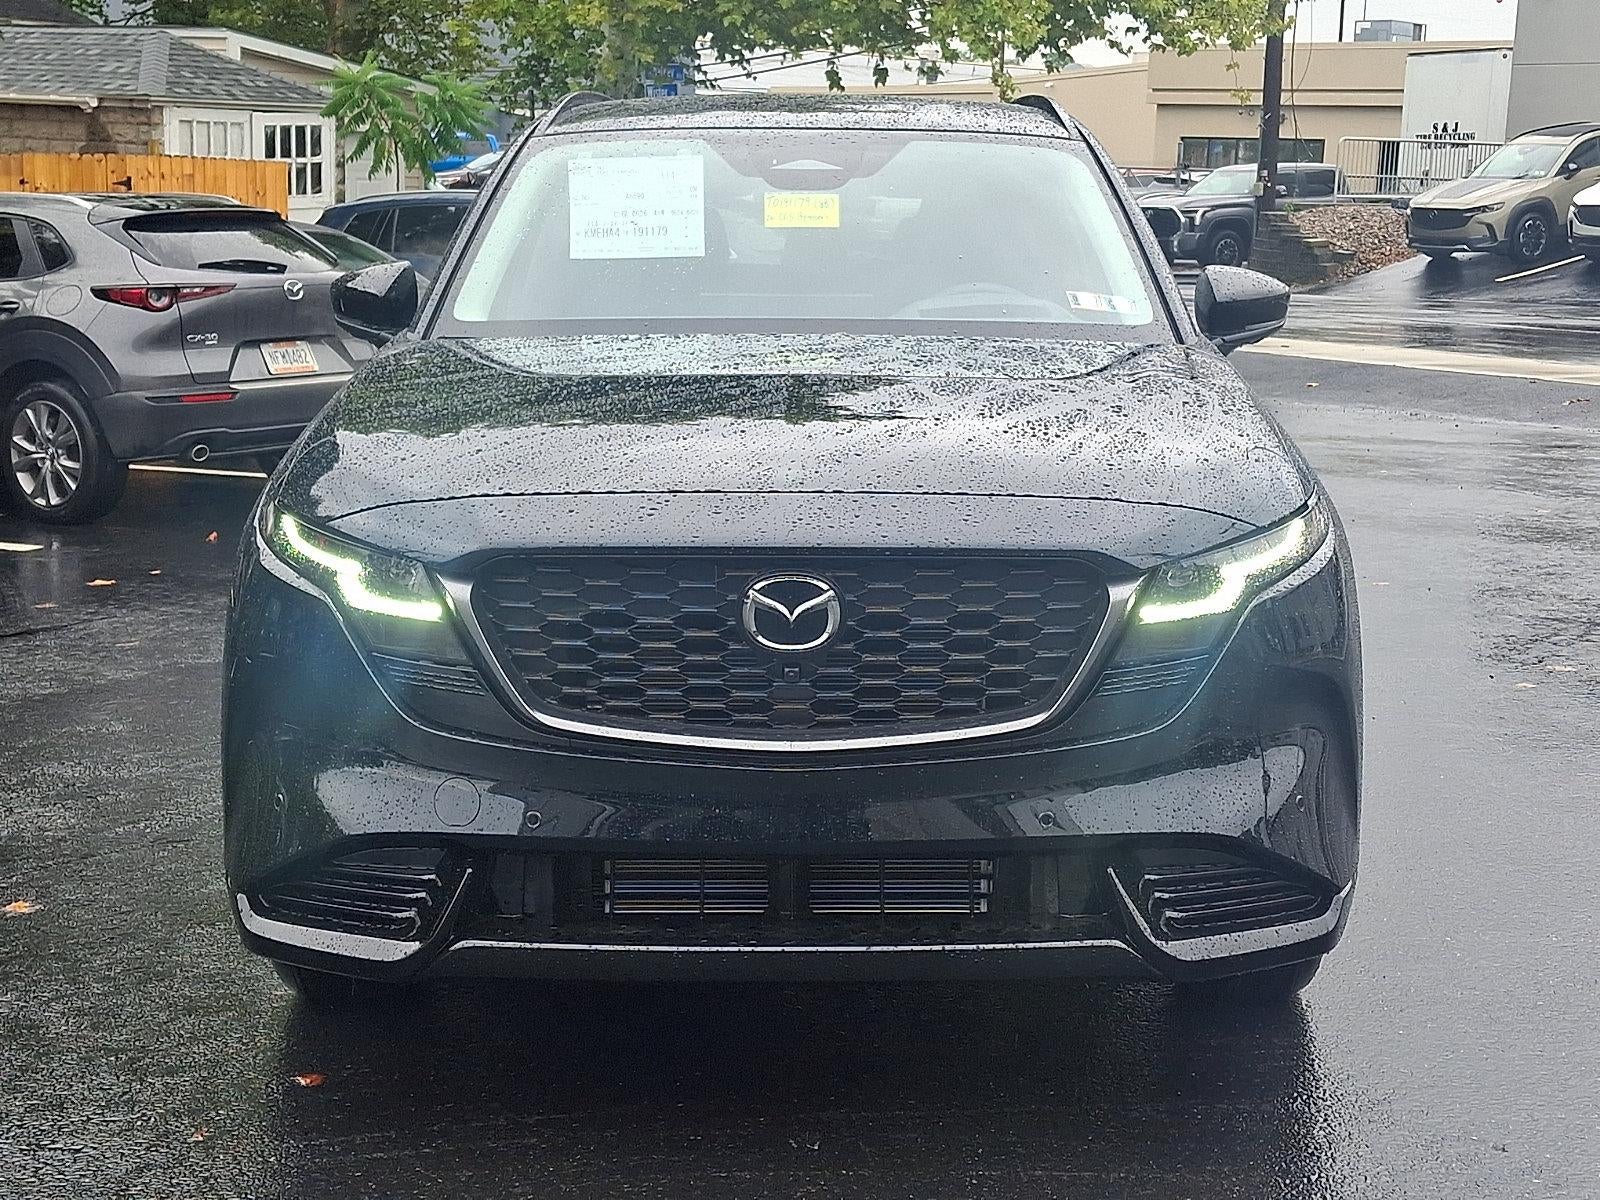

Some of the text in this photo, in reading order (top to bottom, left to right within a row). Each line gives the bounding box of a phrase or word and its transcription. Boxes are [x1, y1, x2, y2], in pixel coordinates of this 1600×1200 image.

[1432, 121, 1459, 133] S & J
[1434, 133, 1475, 141] RECYCLING
